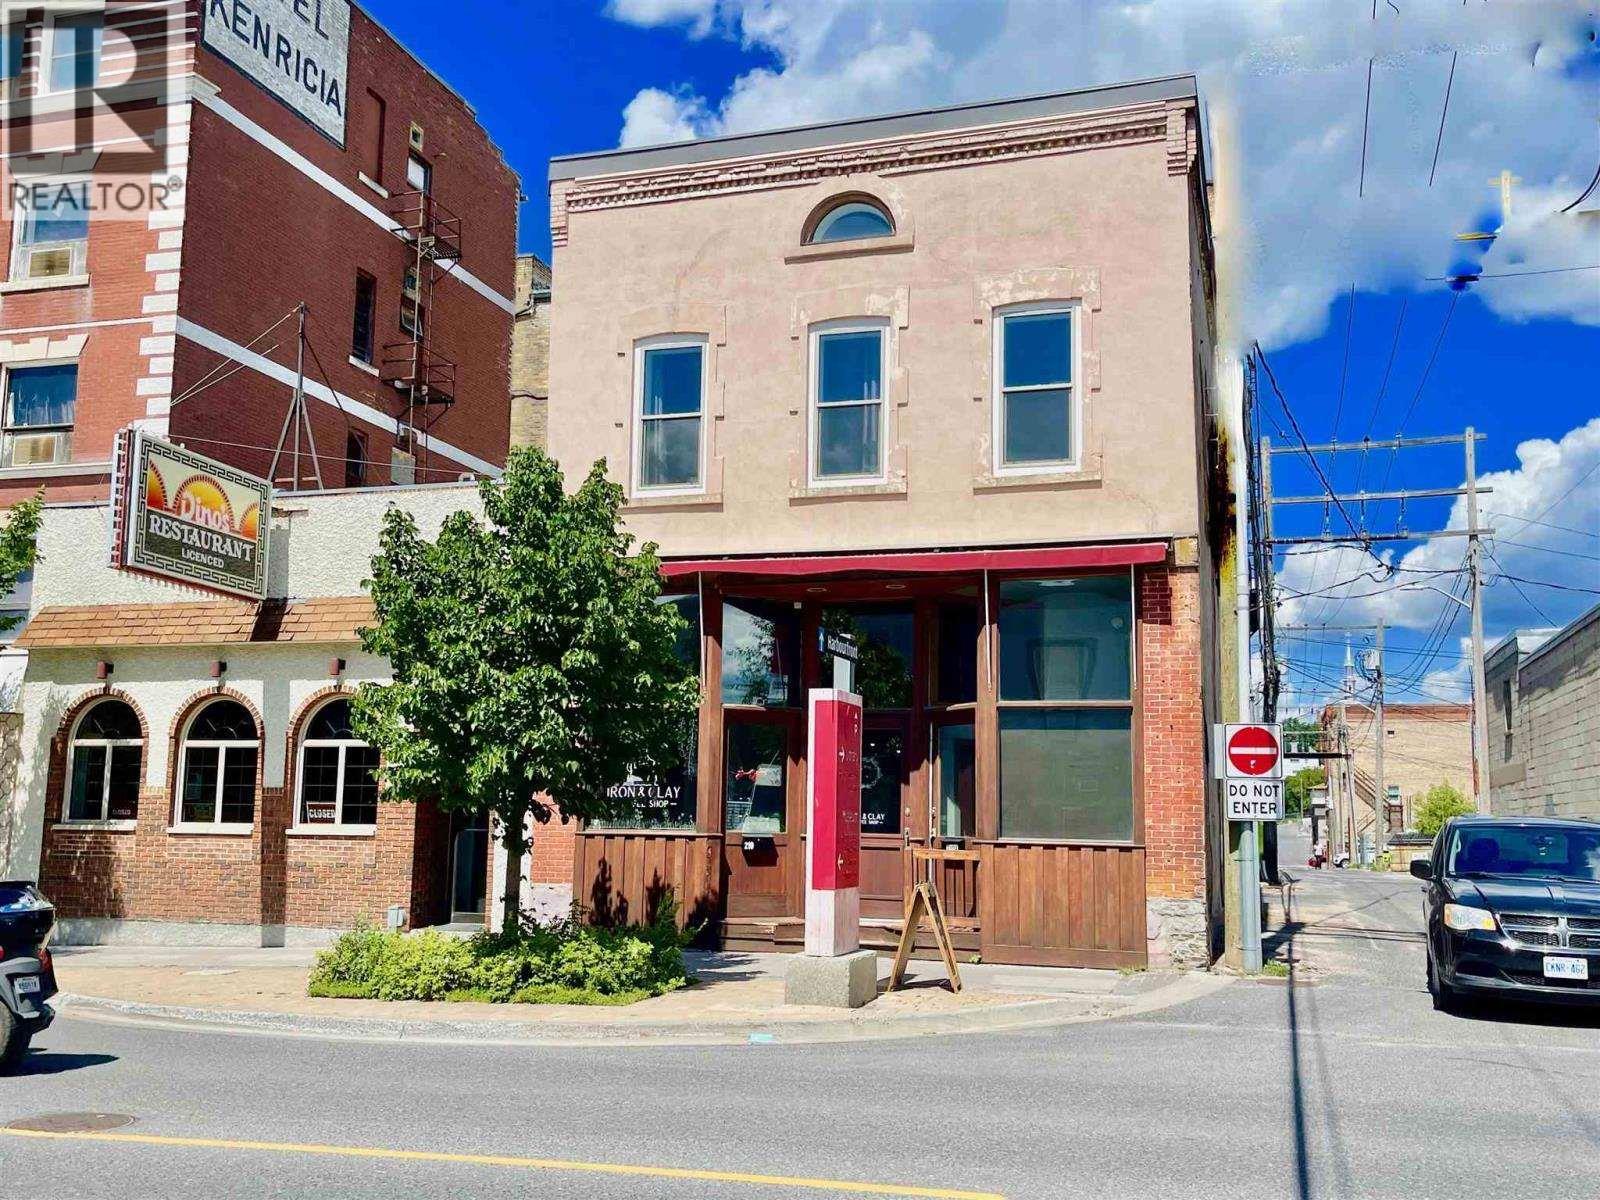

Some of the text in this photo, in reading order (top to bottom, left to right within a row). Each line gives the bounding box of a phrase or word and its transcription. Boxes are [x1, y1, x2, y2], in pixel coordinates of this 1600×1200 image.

[149, 514, 255, 562] RESTAURANT
[181, 548, 225, 569] LICENCED
[607, 786, 635, 799] IRON
[638, 786, 646, 797] &
[1229, 785, 1280, 797] DO NOT
[649, 800, 669, 808] SHOP
[1233, 802, 1277, 814] ENTER
[867, 812, 885, 820] CLAY
